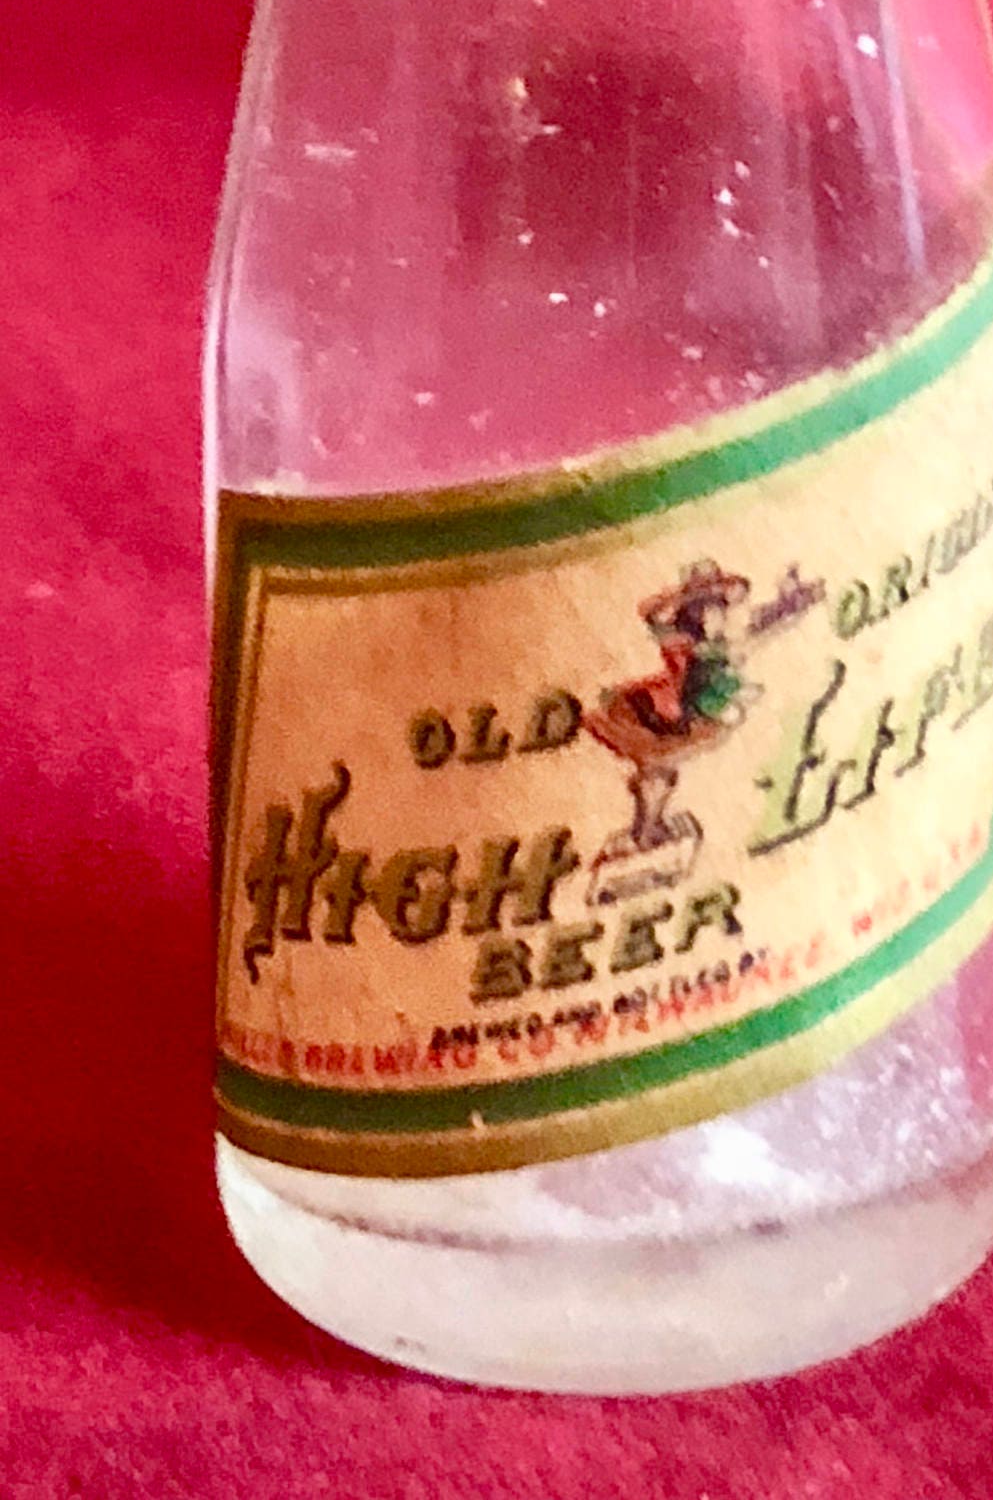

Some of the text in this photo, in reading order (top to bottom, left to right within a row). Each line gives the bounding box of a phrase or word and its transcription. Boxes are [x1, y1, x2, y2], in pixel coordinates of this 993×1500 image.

[408, 687, 583, 771] OLD
[243, 758, 580, 985] HIGH
[469, 880, 742, 1006] BEER
